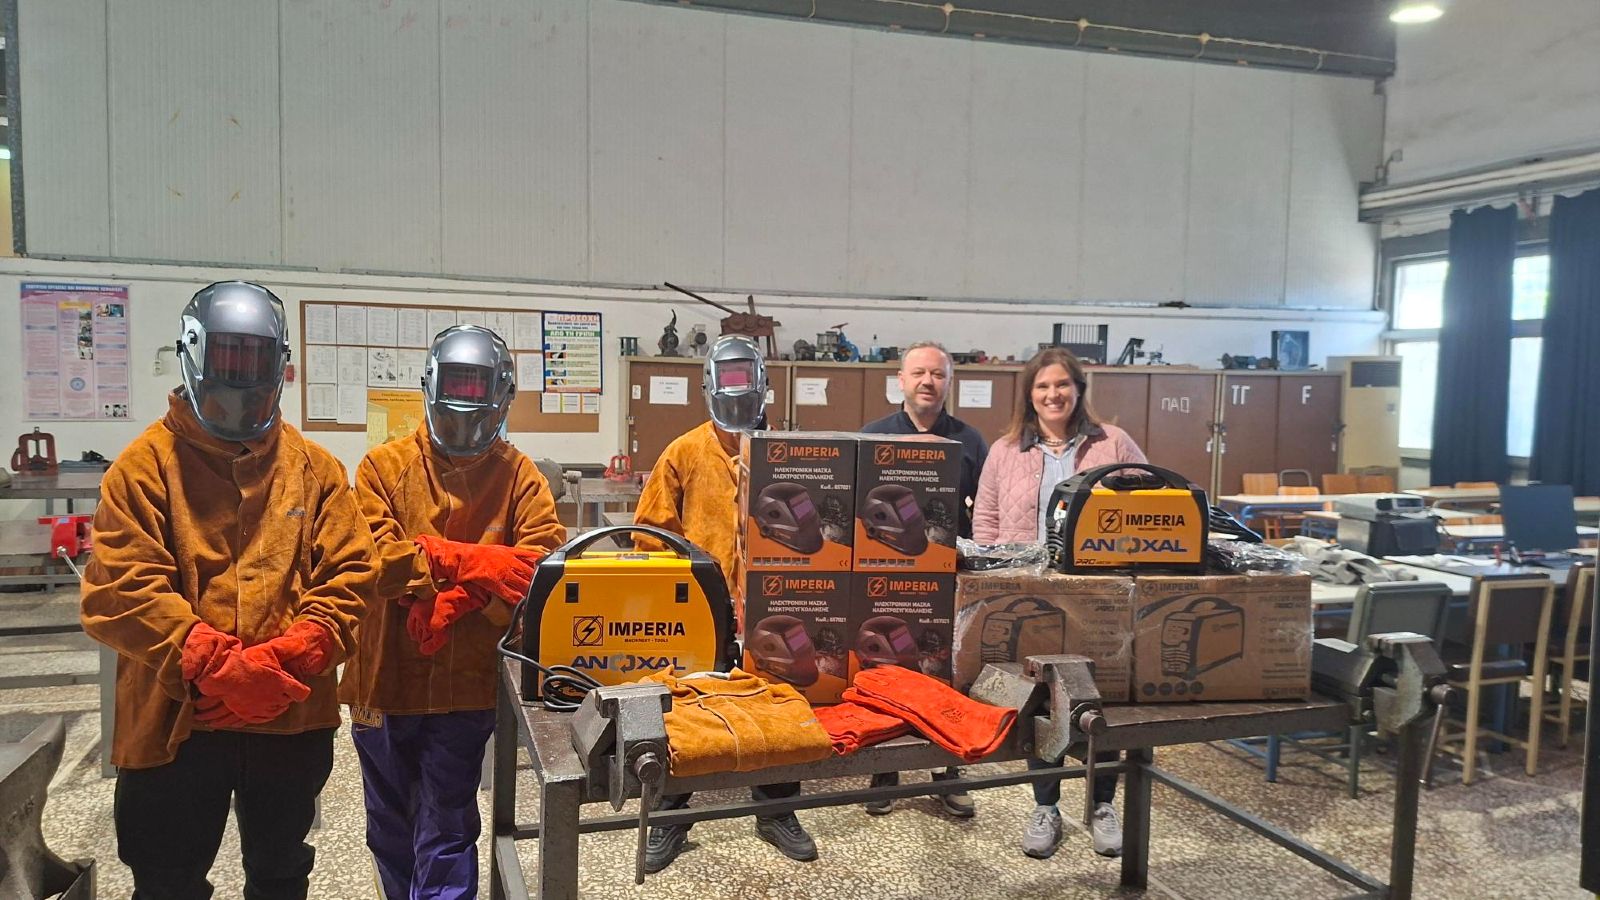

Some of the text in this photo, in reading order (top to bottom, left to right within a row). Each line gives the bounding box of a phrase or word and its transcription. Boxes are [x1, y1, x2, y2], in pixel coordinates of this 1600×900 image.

[790, 446, 840, 457] IMPERIA
[897, 449, 945, 460] IMPERIA
[1125, 514, 1185, 526] IMPERIA
[785, 579, 835, 590] IMPERIA
[889, 580, 940, 591] IMPERIA
[980, 582, 1021, 590] IMPERIA
[1159, 583, 1199, 592] IMPERIA
[608, 622, 686, 636] IMPERIA
